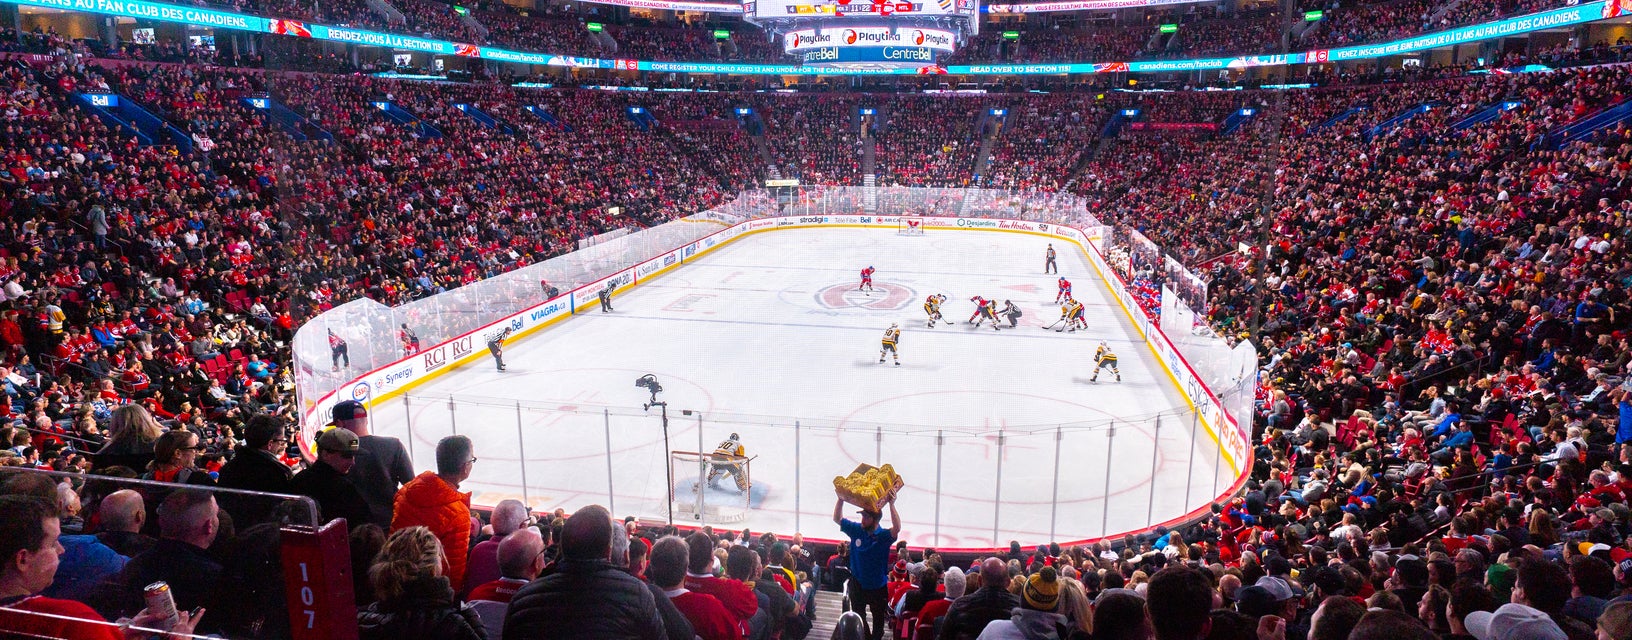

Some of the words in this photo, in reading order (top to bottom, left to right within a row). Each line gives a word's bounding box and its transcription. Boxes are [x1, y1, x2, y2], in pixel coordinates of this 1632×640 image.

[75, 0, 94, 8] AU
[98, 1, 124, 13] FAN
[127, 3, 159, 17] CLUB
[161, 7, 184, 20] DES
[186, 11, 249, 28] CANADIENS.
[851, 4, 871, 12] 11:22
[328, 28, 385, 45] RENDEZ-VOUS
[385, 34, 392, 46] À
[392, 37, 403, 47] LA
[403, 38, 432, 50] SECTION
[799, 33, 830, 45] Playtika
[858, 31, 900, 43] Playtika
[925, 33, 949, 45] Playtika
[1337, 50, 1357, 59] VENEZ
[1413, 38, 1437, 49] PARTISAN
[1462, 30, 1474, 39] ANS
[1475, 28, 1484, 38] AU
[1485, 25, 1498, 36] FAN
[1499, 22, 1516, 34] CLUB
[1517, 19, 1531, 31] DES
[1533, 10, 1580, 27] CANADIENS.
[882, 46, 932, 60] CentreBell
[1139, 60, 1223, 70] canadiens.com/fanclub
[91, 95, 109, 106] Bell
[800, 216, 823, 224] stradigi
[966, 219, 996, 227] Desjardins
[998, 220, 1010, 229] Tim
[1010, 221, 1034, 231] Hortons
[530, 301, 566, 321] VIAGRA.ca
[511, 315, 524, 332] Bell
[452, 335, 473, 356] RCI
[424, 346, 446, 368] RCI
[385, 366, 413, 385] Synergy
[354, 386, 368, 397] Esso
[299, 562, 316, 629] 107
